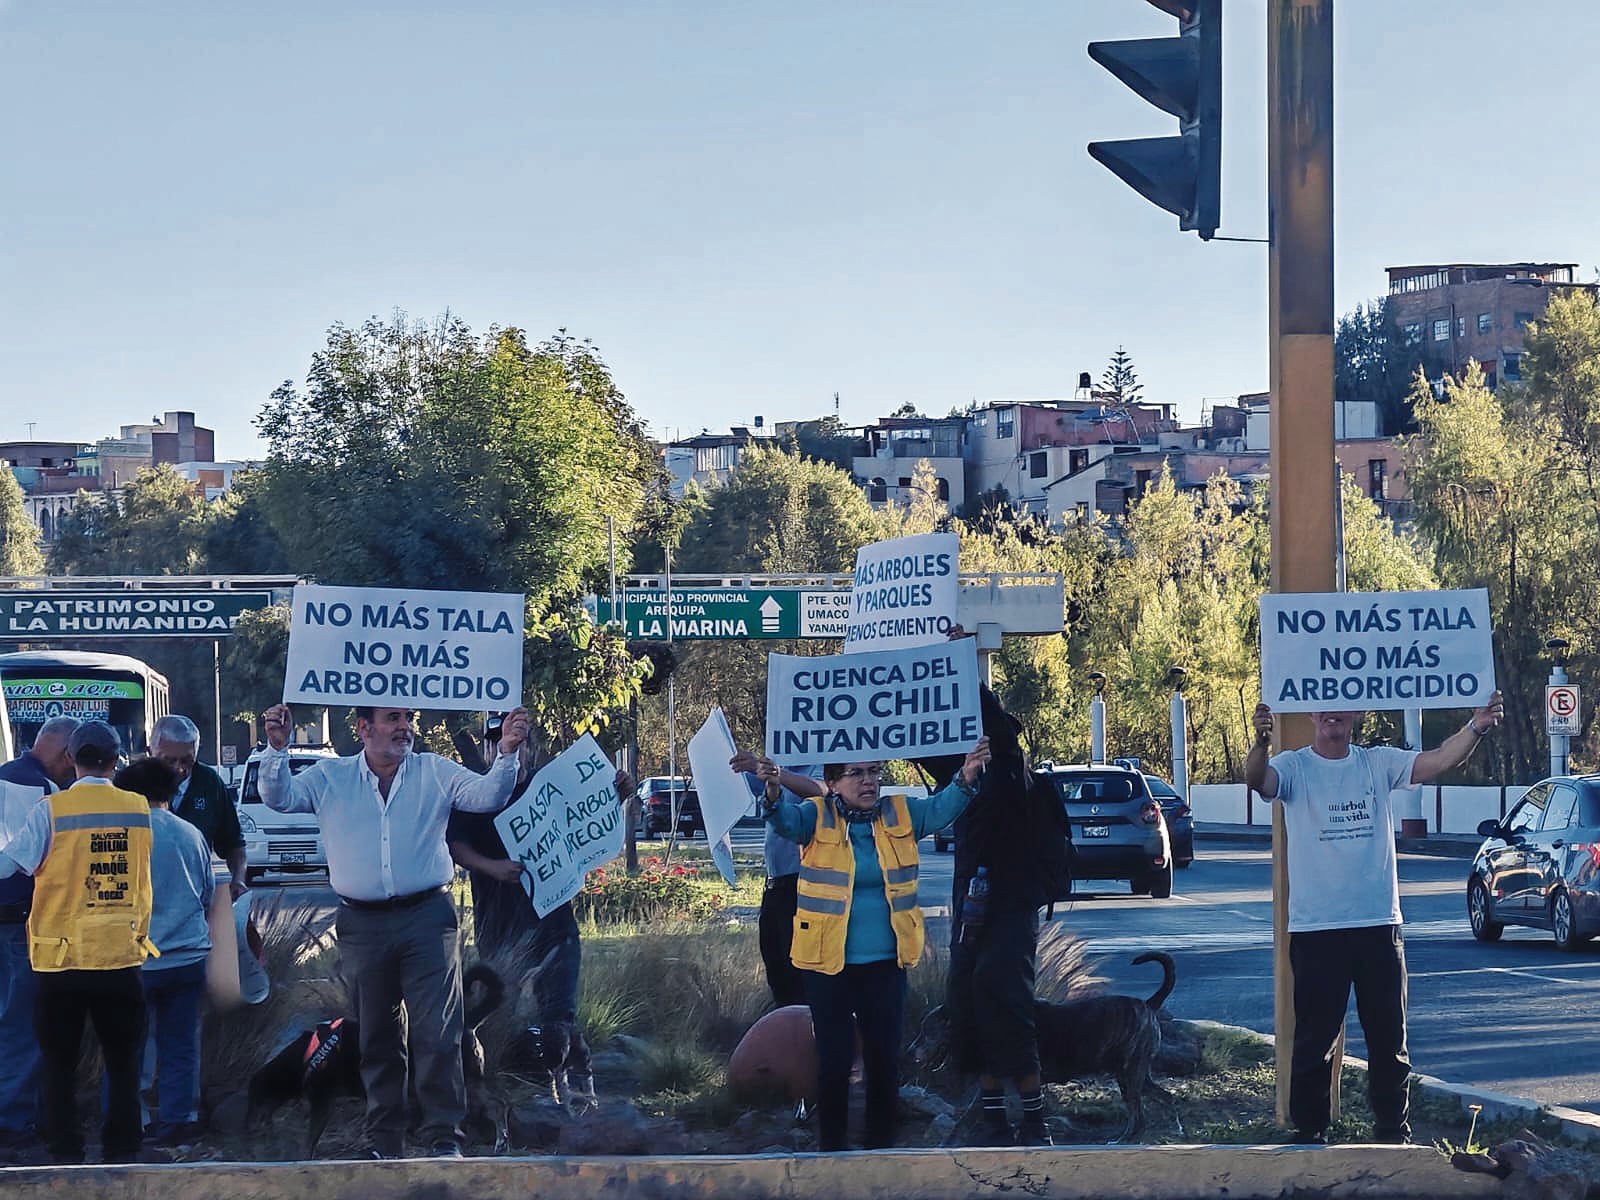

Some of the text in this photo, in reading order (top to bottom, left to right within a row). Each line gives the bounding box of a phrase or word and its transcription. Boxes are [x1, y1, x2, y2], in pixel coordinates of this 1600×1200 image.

[876, 553, 951, 582] ARBOLES
[14, 600, 215, 613] PATRIMONIO
[645, 605, 706, 616] AREQUIPA
[687, 593, 749, 603] PROVINCIAL
[857, 583, 932, 613] Y PARQUES
[9, 617, 49, 630] LA
[305, 600, 515, 634] NO MÁS TALA
[638, 620, 664, 636] LA
[670, 619, 748, 636] MARINA
[879, 615, 951, 638] CEMENTO
[1277, 603, 1476, 634] NO MÁS TALA
[343, 639, 470, 669] NO MÁS
[1320, 640, 1441, 671] NO MÁS
[299, 669, 510, 701] ARBORICIDIO
[793, 656, 958, 691] CUENCA DEL
[1278, 672, 1479, 702] ARBORICIDIO
[63, 700, 84, 711] SAN
[791, 682, 960, 723] RIO CHILI
[773, 715, 978, 755] INTANGIBLE
[509, 753, 605, 844] BASTA DE
[1345, 810, 1370, 821] vida
[519, 819, 562, 865] MATAR
[89, 862, 128, 875] PARQUE
[537, 854, 563, 882] EN
